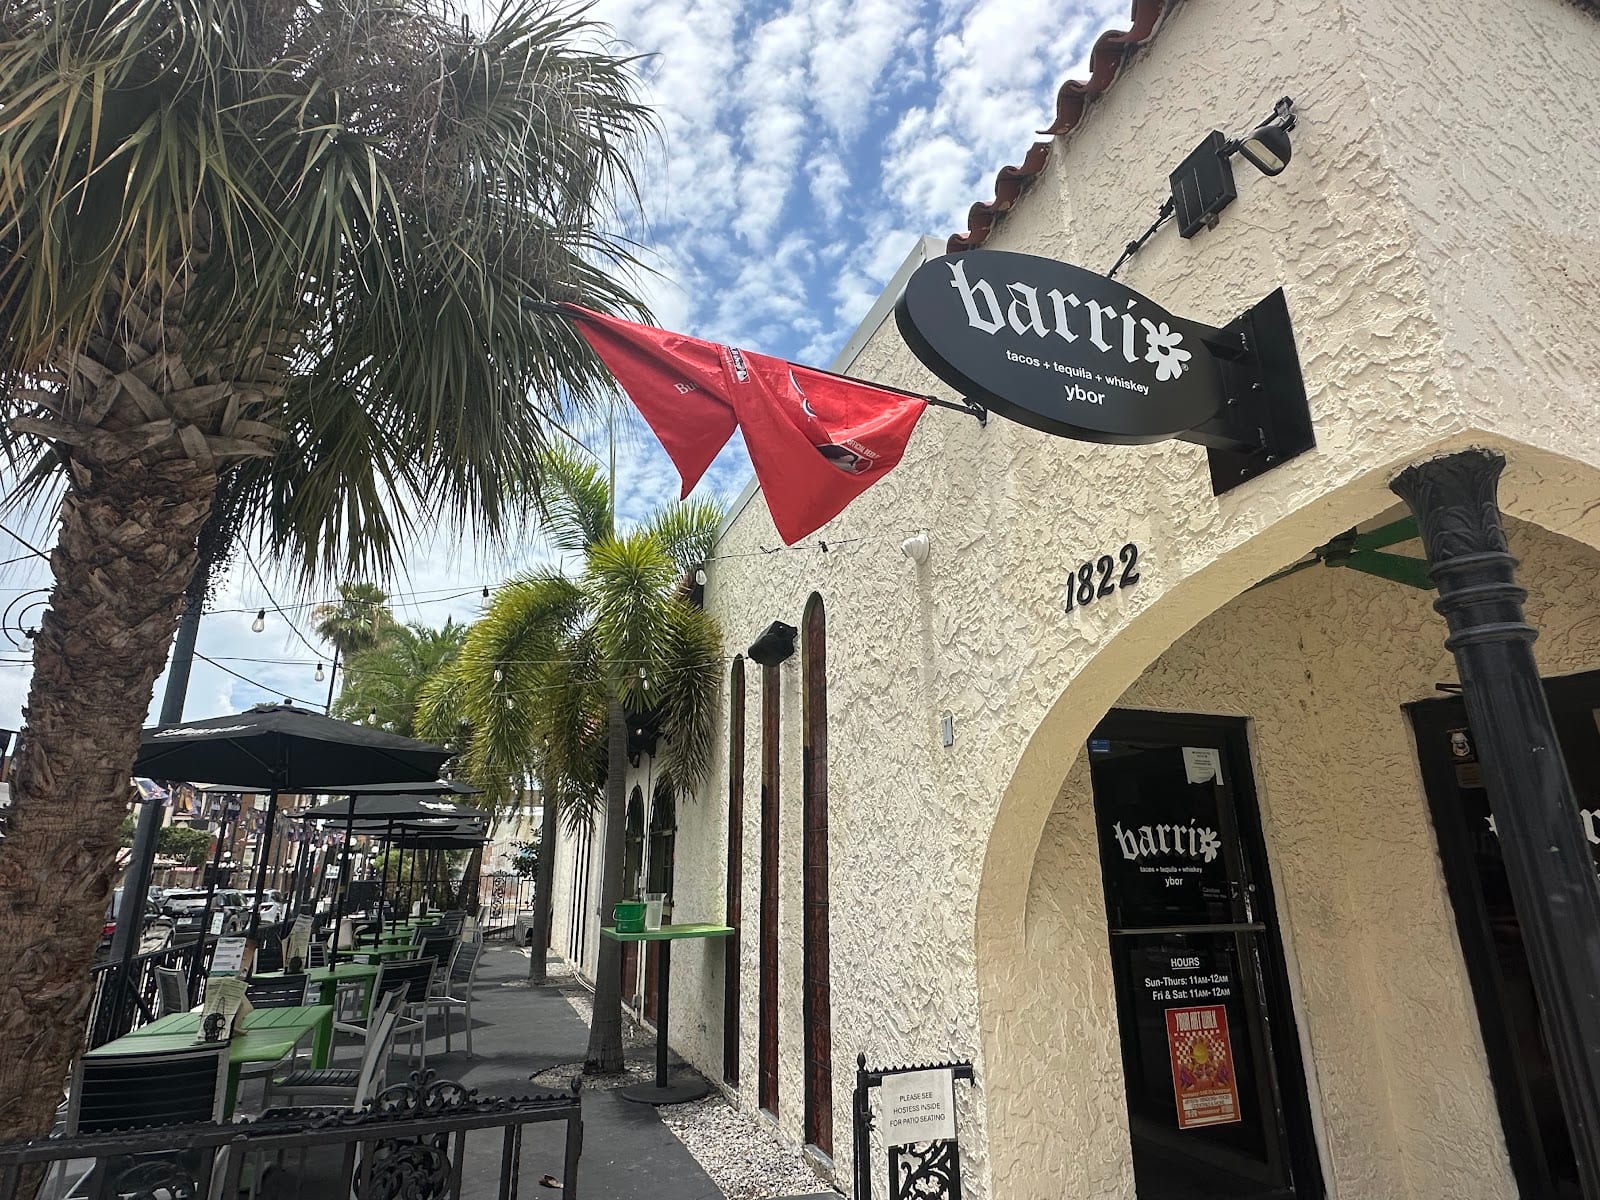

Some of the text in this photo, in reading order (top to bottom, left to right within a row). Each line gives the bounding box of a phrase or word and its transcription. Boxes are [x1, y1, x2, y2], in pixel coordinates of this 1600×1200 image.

[1005, 350, 1041, 368] tacos
[1053, 361, 1093, 381] tequila
[1104, 374, 1150, 396] whiskey
[1064, 383, 1106, 405] ybor
[1065, 543, 1139, 614] 1822
[1165, 876, 1184, 887] ybor
[1170, 957, 1200, 968] HOURS
[1144, 976, 1188, 988] Sun-Thurs:
[1152, 990, 1164, 1000] Fri
[1165, 990, 1171, 999] &
[1172, 990, 1188, 999] Sat:
[899, 1091, 933, 1102] PLEASE SEE
[893, 1102, 941, 1114] HOSTESS INSIDE
[890, 1113, 945, 1127] FOR PATIO SEATING
